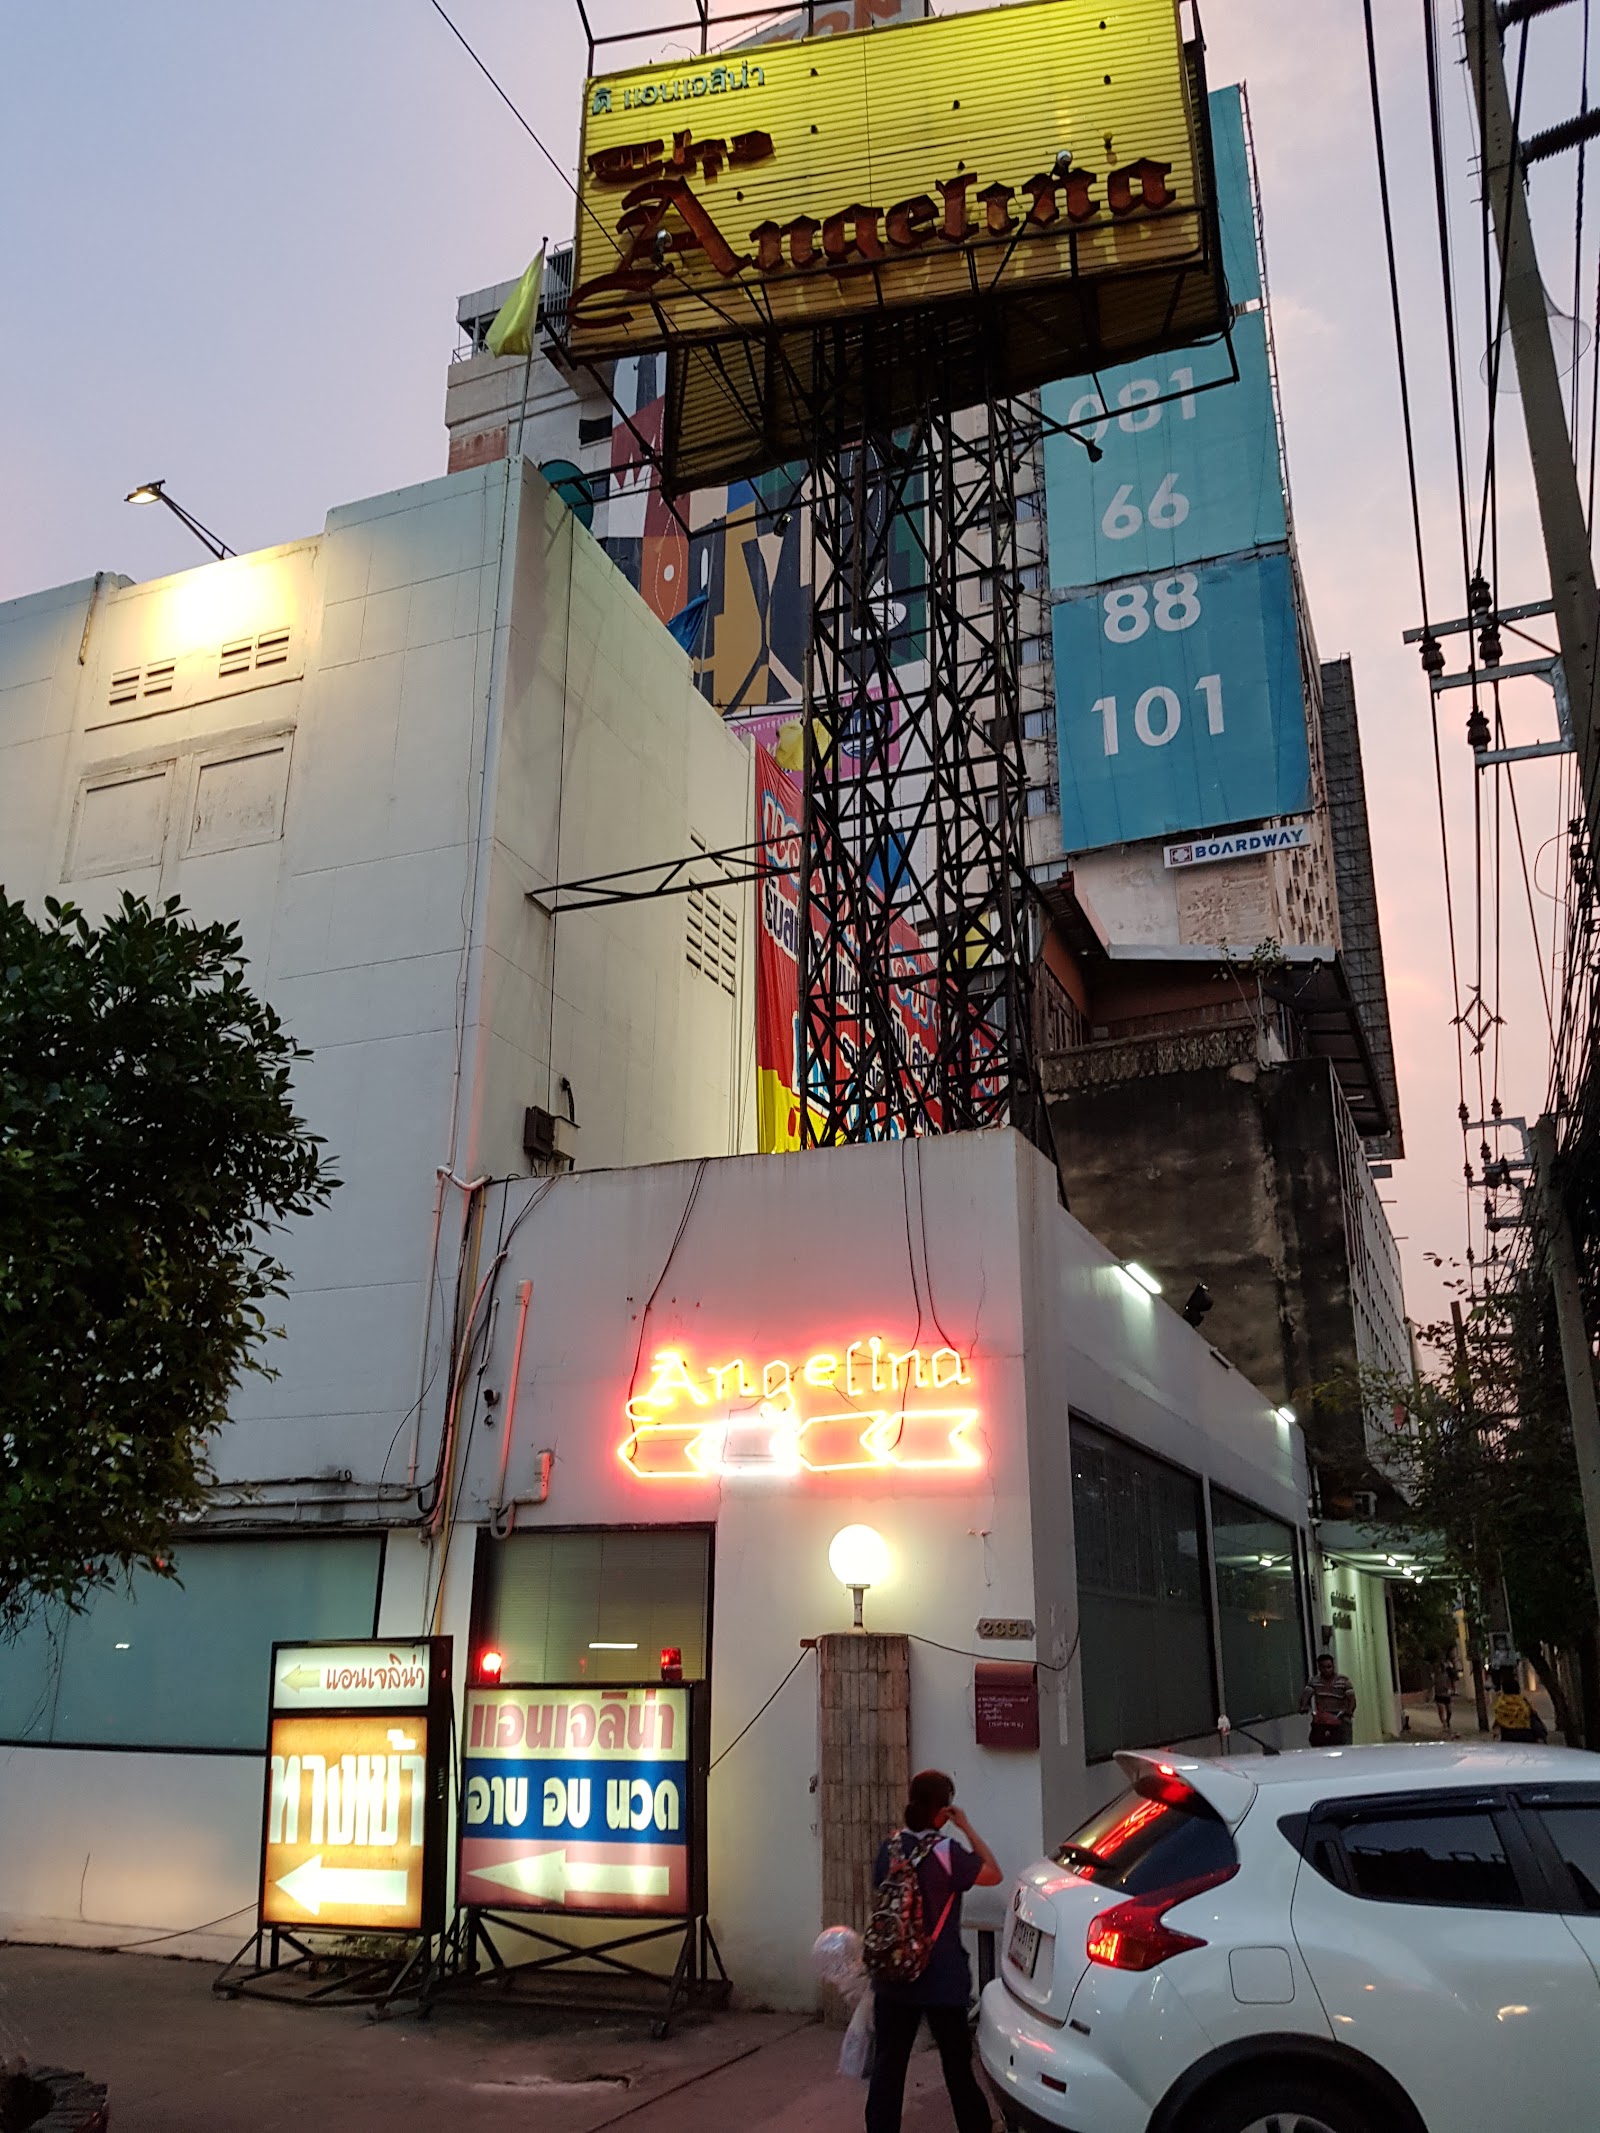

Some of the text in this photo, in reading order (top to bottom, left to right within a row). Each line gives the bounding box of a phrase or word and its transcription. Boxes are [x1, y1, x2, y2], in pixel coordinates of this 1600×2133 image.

[567, 157, 1177, 330] Angelina
[1067, 366, 1197, 448] 081
[1101, 472, 1191, 541] 66
[1103, 571, 1202, 644] 88
[1090, 673, 1225, 757] 101
[1195, 829, 1304, 859] BOARDWAY
[625, 1336, 973, 1422] Angelina
[267, 1728, 425, 1847] ทางเข้า
[466, 1775, 529, 1828] อาบ
[542, 1777, 591, 1829] อบ
[606, 1777, 680, 1832] นวด
